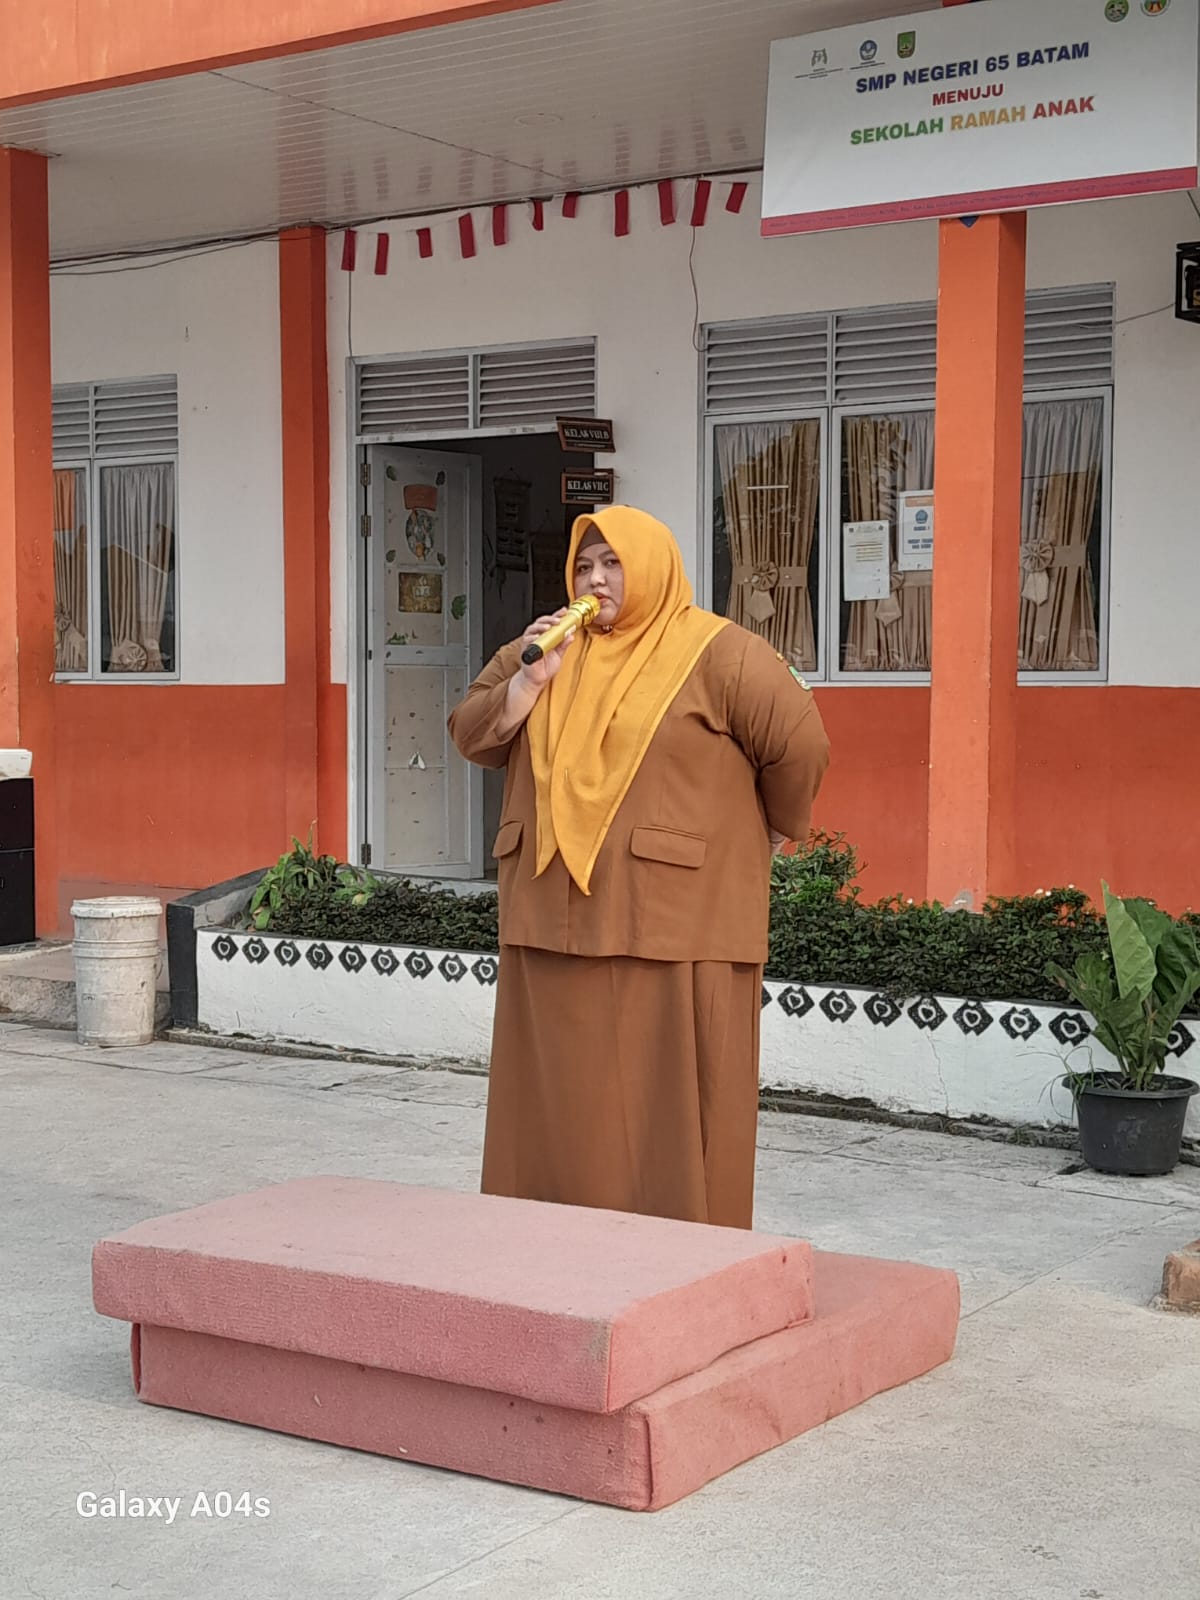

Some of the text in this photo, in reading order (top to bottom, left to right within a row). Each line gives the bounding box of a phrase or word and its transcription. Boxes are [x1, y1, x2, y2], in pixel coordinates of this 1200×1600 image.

[856, 73, 896, 93] SMP
[903, 59, 978, 86] NEGERI
[985, 54, 1009, 73] 65
[1016, 41, 1089, 68] BATAM
[932, 83, 1004, 106] MENUJU
[850, 95, 1095, 145] SEKOLAH RAMAH ANAK
[564, 428, 589, 438] KELAS
[567, 480, 592, 491] KELAS
